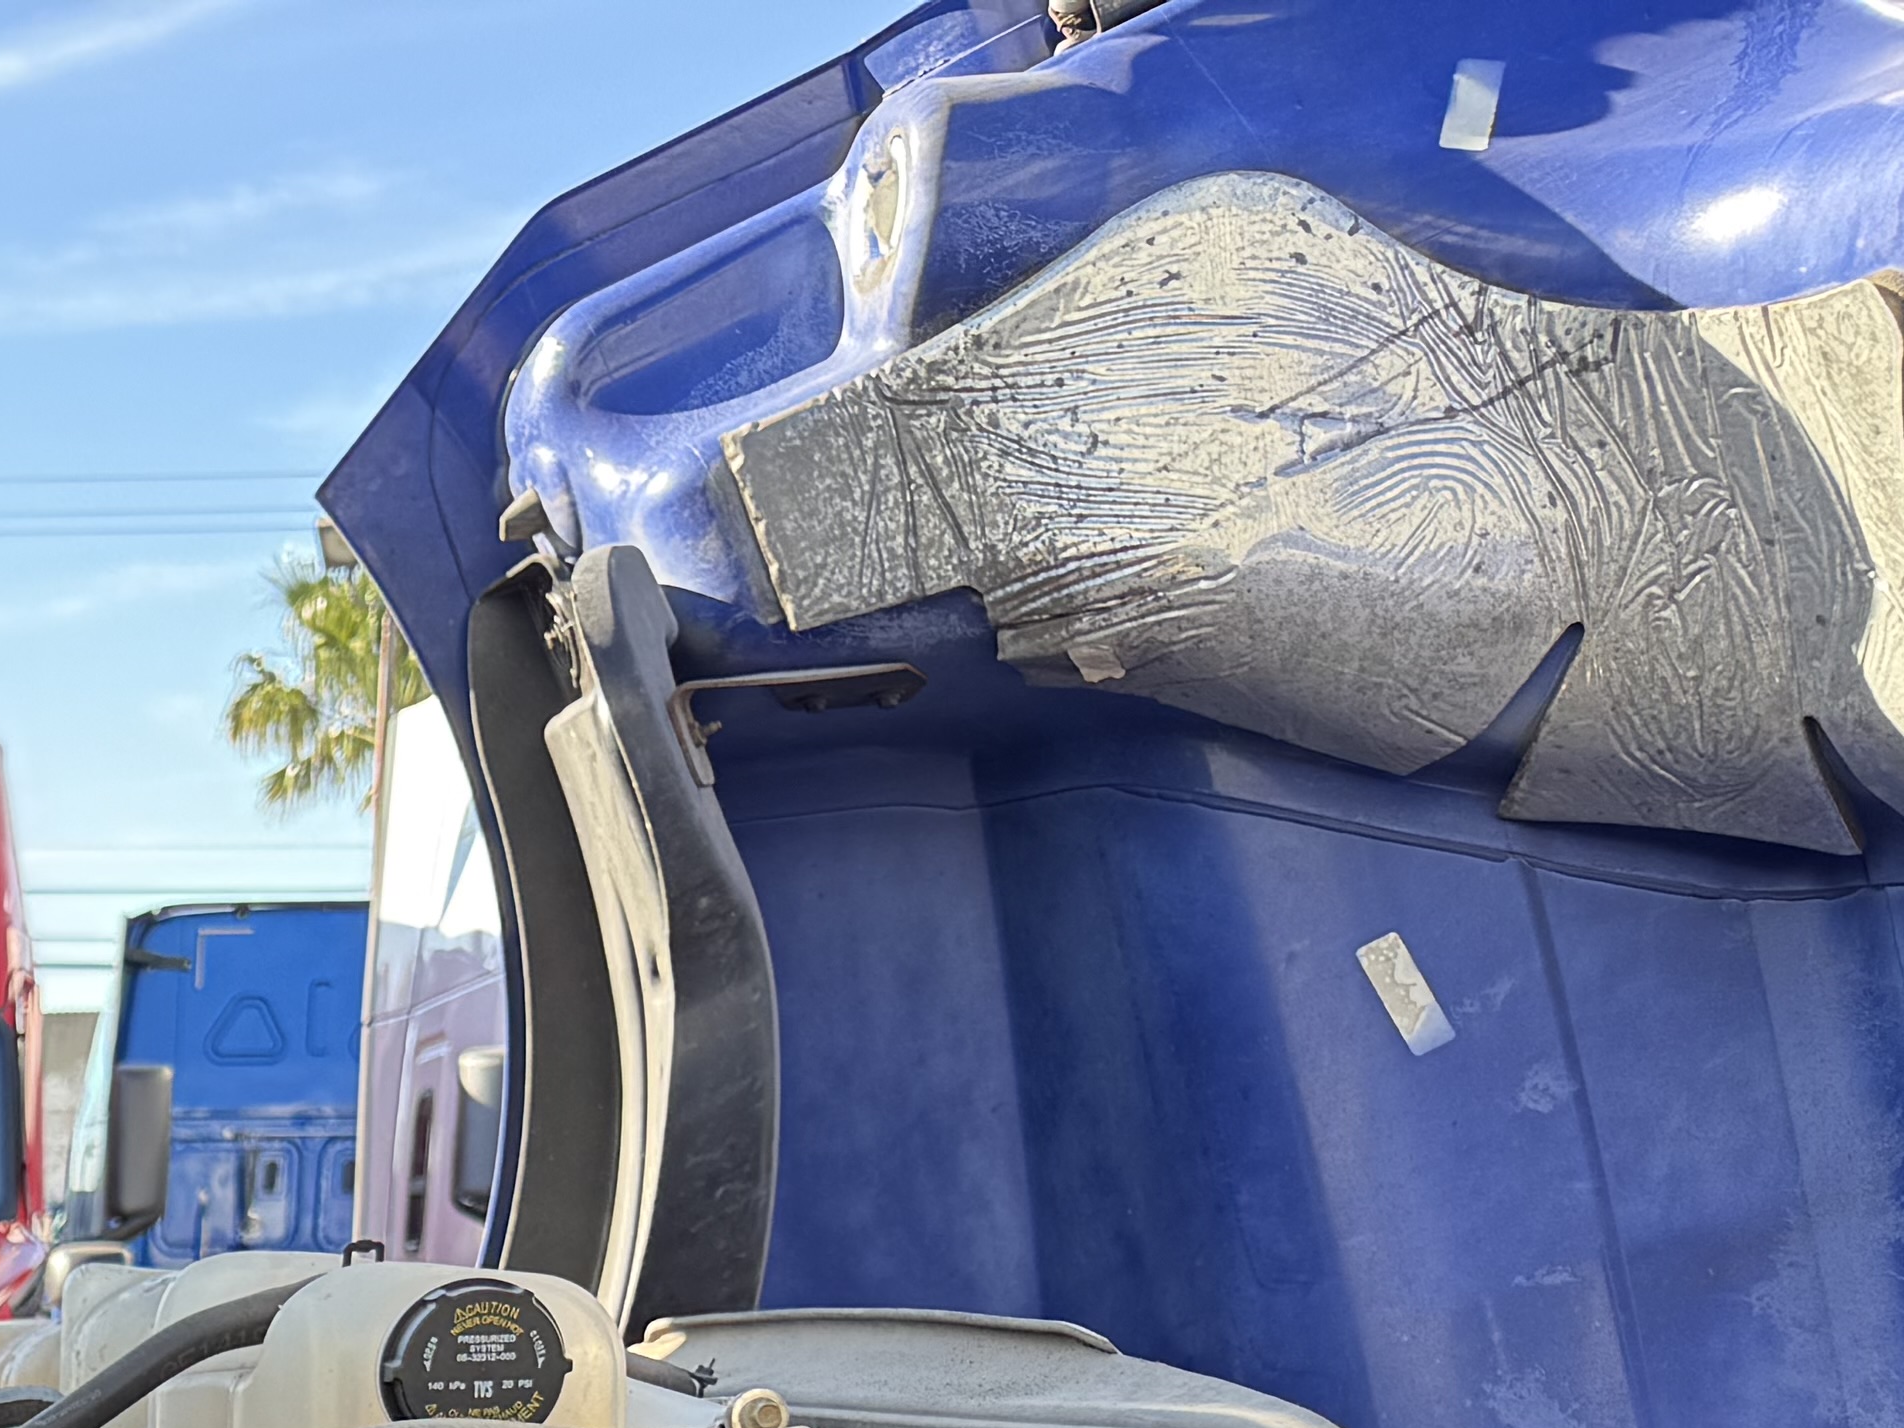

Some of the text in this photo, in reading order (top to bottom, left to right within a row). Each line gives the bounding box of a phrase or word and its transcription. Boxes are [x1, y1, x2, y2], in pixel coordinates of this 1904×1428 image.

[466, 1301, 520, 1320] CAUTION
[450, 1316, 480, 1336] NEVER
[457, 1334, 516, 1344] PRESSURIZED
[469, 1344, 504, 1353] SYSTEM
[428, 1381, 444, 1391] 140
[473, 1380, 494, 1398] TVS
[502, 1380, 514, 1390] 20
[518, 1379, 533, 1389] PSI
